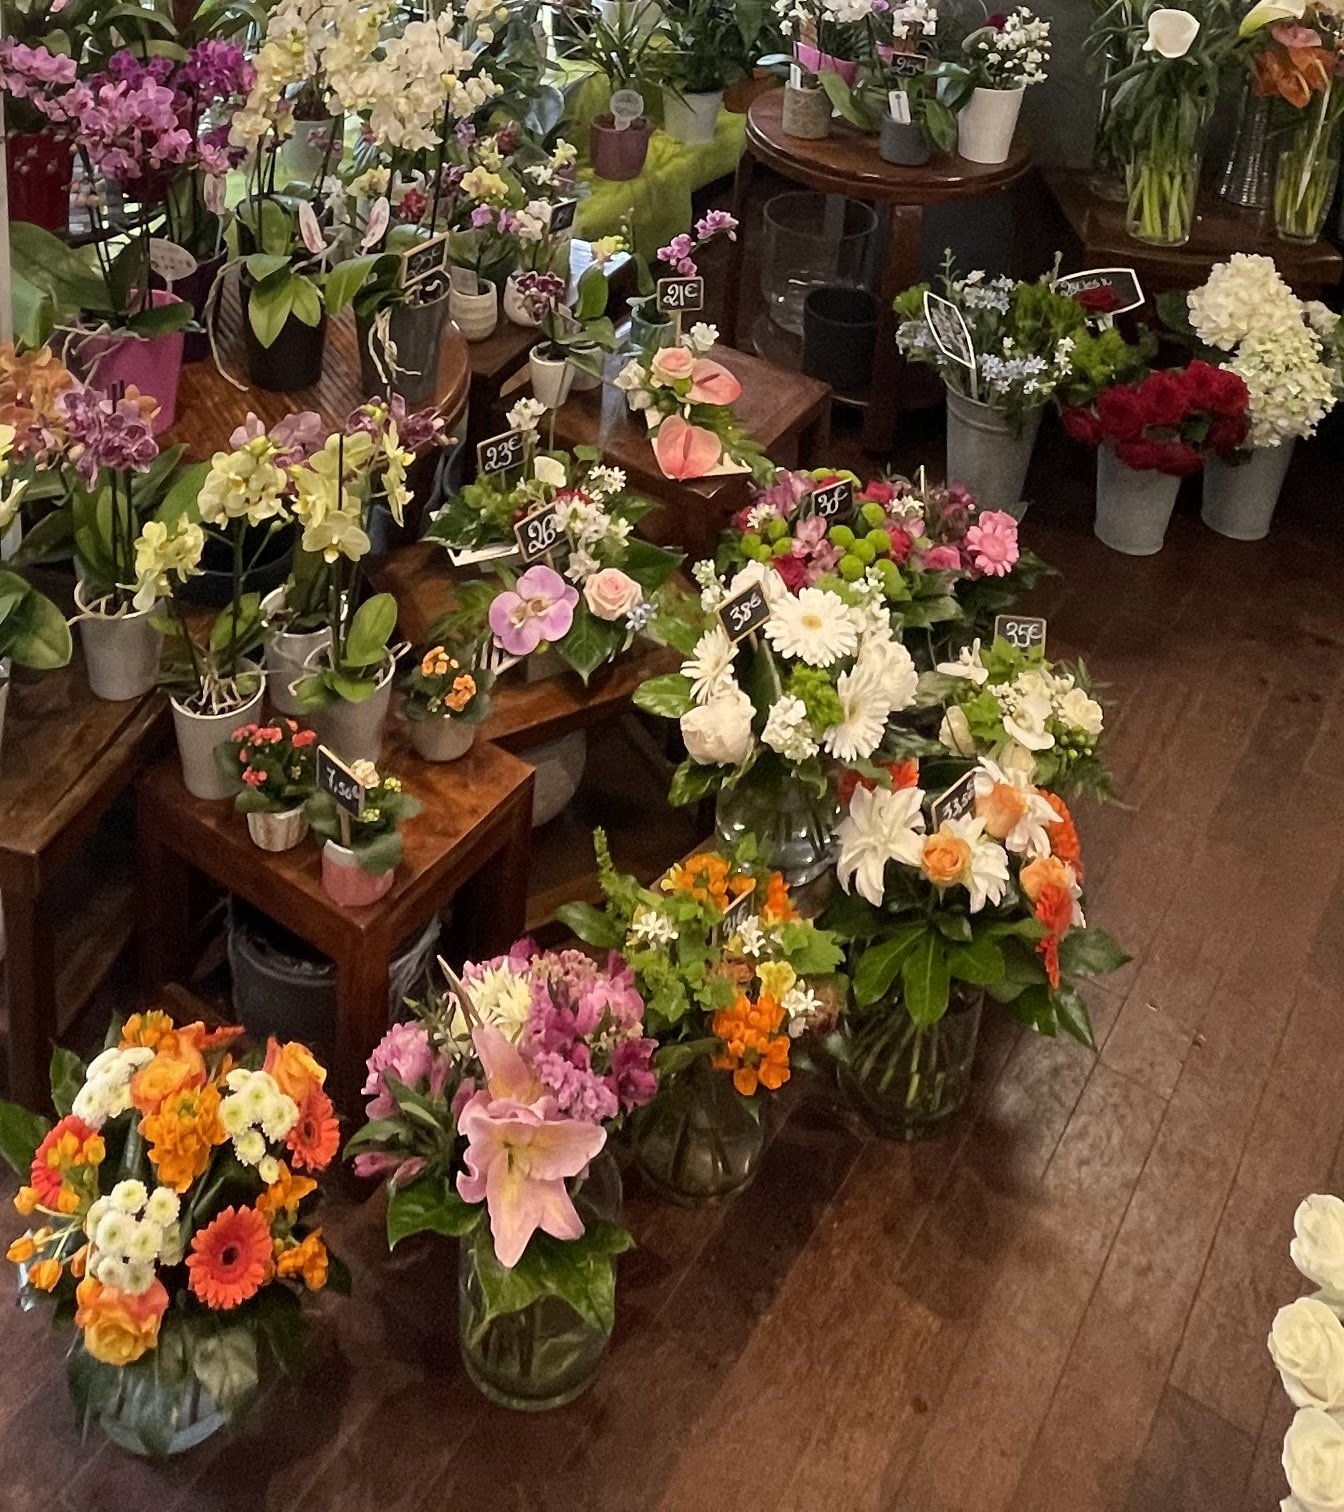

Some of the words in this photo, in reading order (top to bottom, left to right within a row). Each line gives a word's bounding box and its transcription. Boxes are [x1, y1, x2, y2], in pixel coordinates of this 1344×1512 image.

[663, 283, 698, 307] 21€
[484, 436, 524, 471] 23€
[527, 513, 558, 554] 26
[729, 592, 762, 632] 38€
[1006, 621, 1043, 648] 35€
